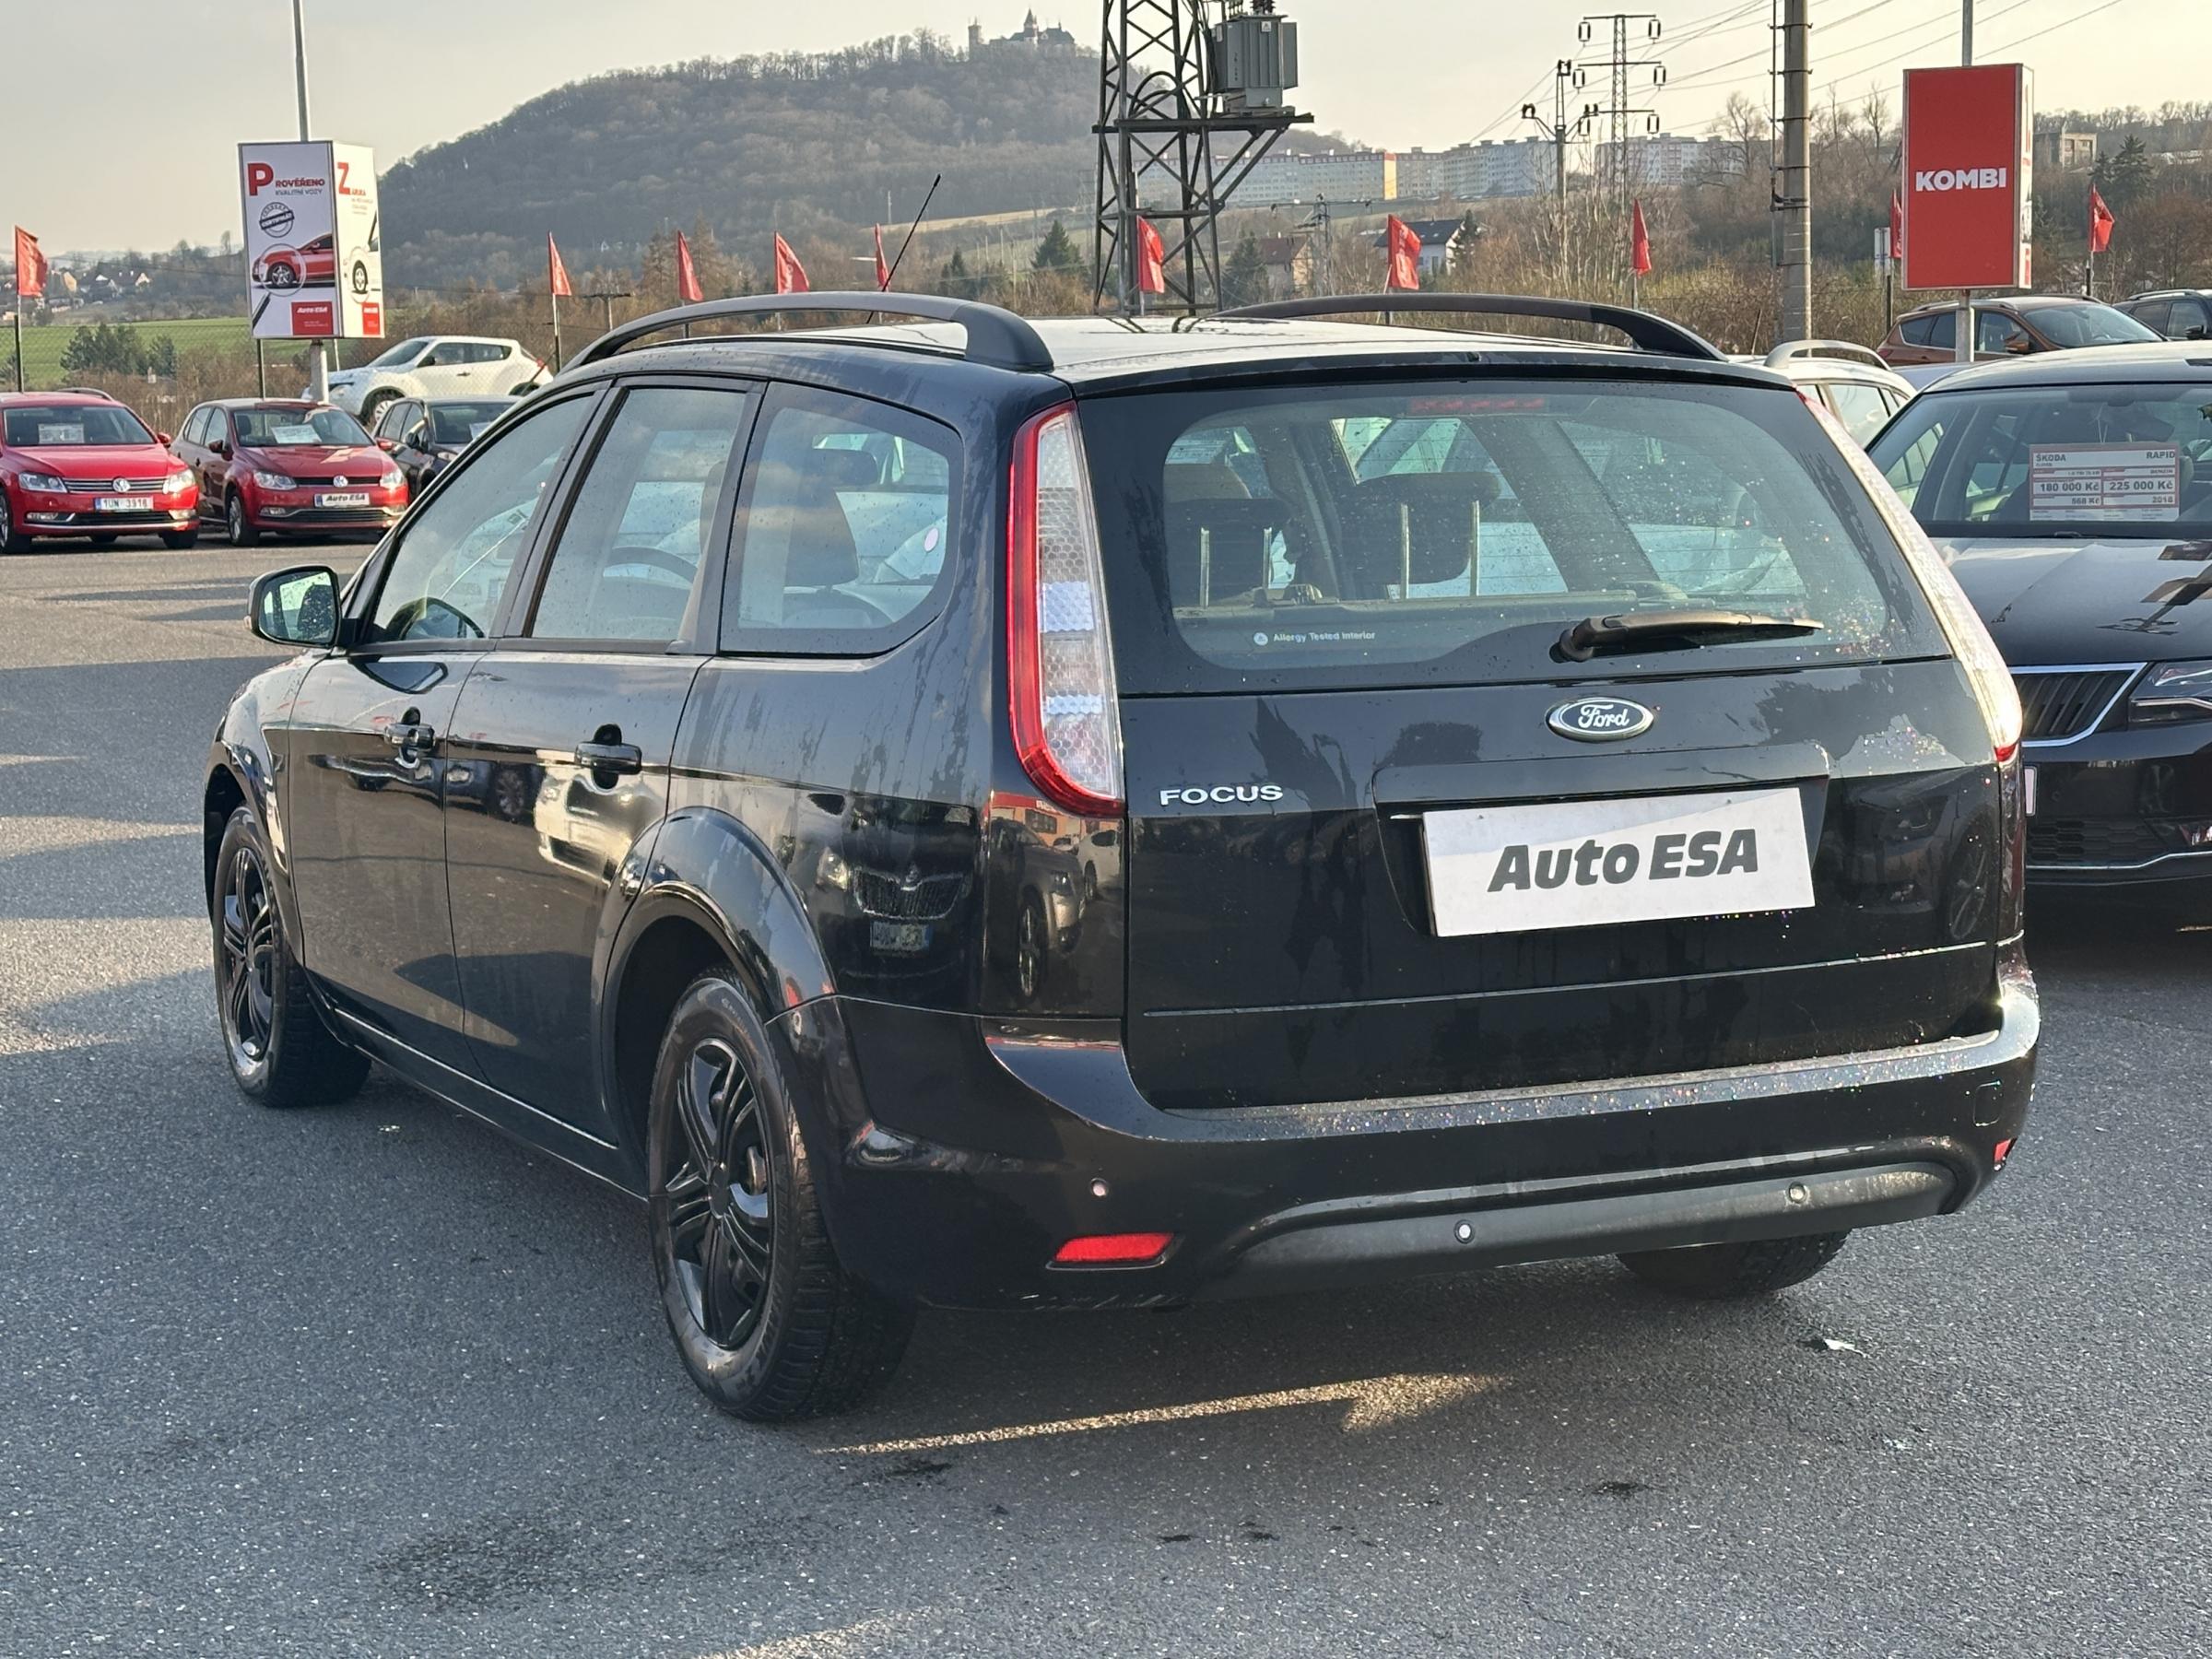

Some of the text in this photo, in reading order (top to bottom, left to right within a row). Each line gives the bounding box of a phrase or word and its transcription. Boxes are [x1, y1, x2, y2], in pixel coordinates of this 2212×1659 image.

[1915, 168, 2006, 192] KOMBI
[2035, 453, 2066, 462] ŠKODA
[2040, 481, 2100, 492] 180 000 Kč
[2109, 480, 2173, 491] 225 000 Kč
[1273, 630, 1376, 642] Allergy Tested Interior
[1578, 704, 1630, 728] Ford
[1159, 784, 1284, 806] FOCUS
[1487, 829, 1759, 893] Auto ESA
